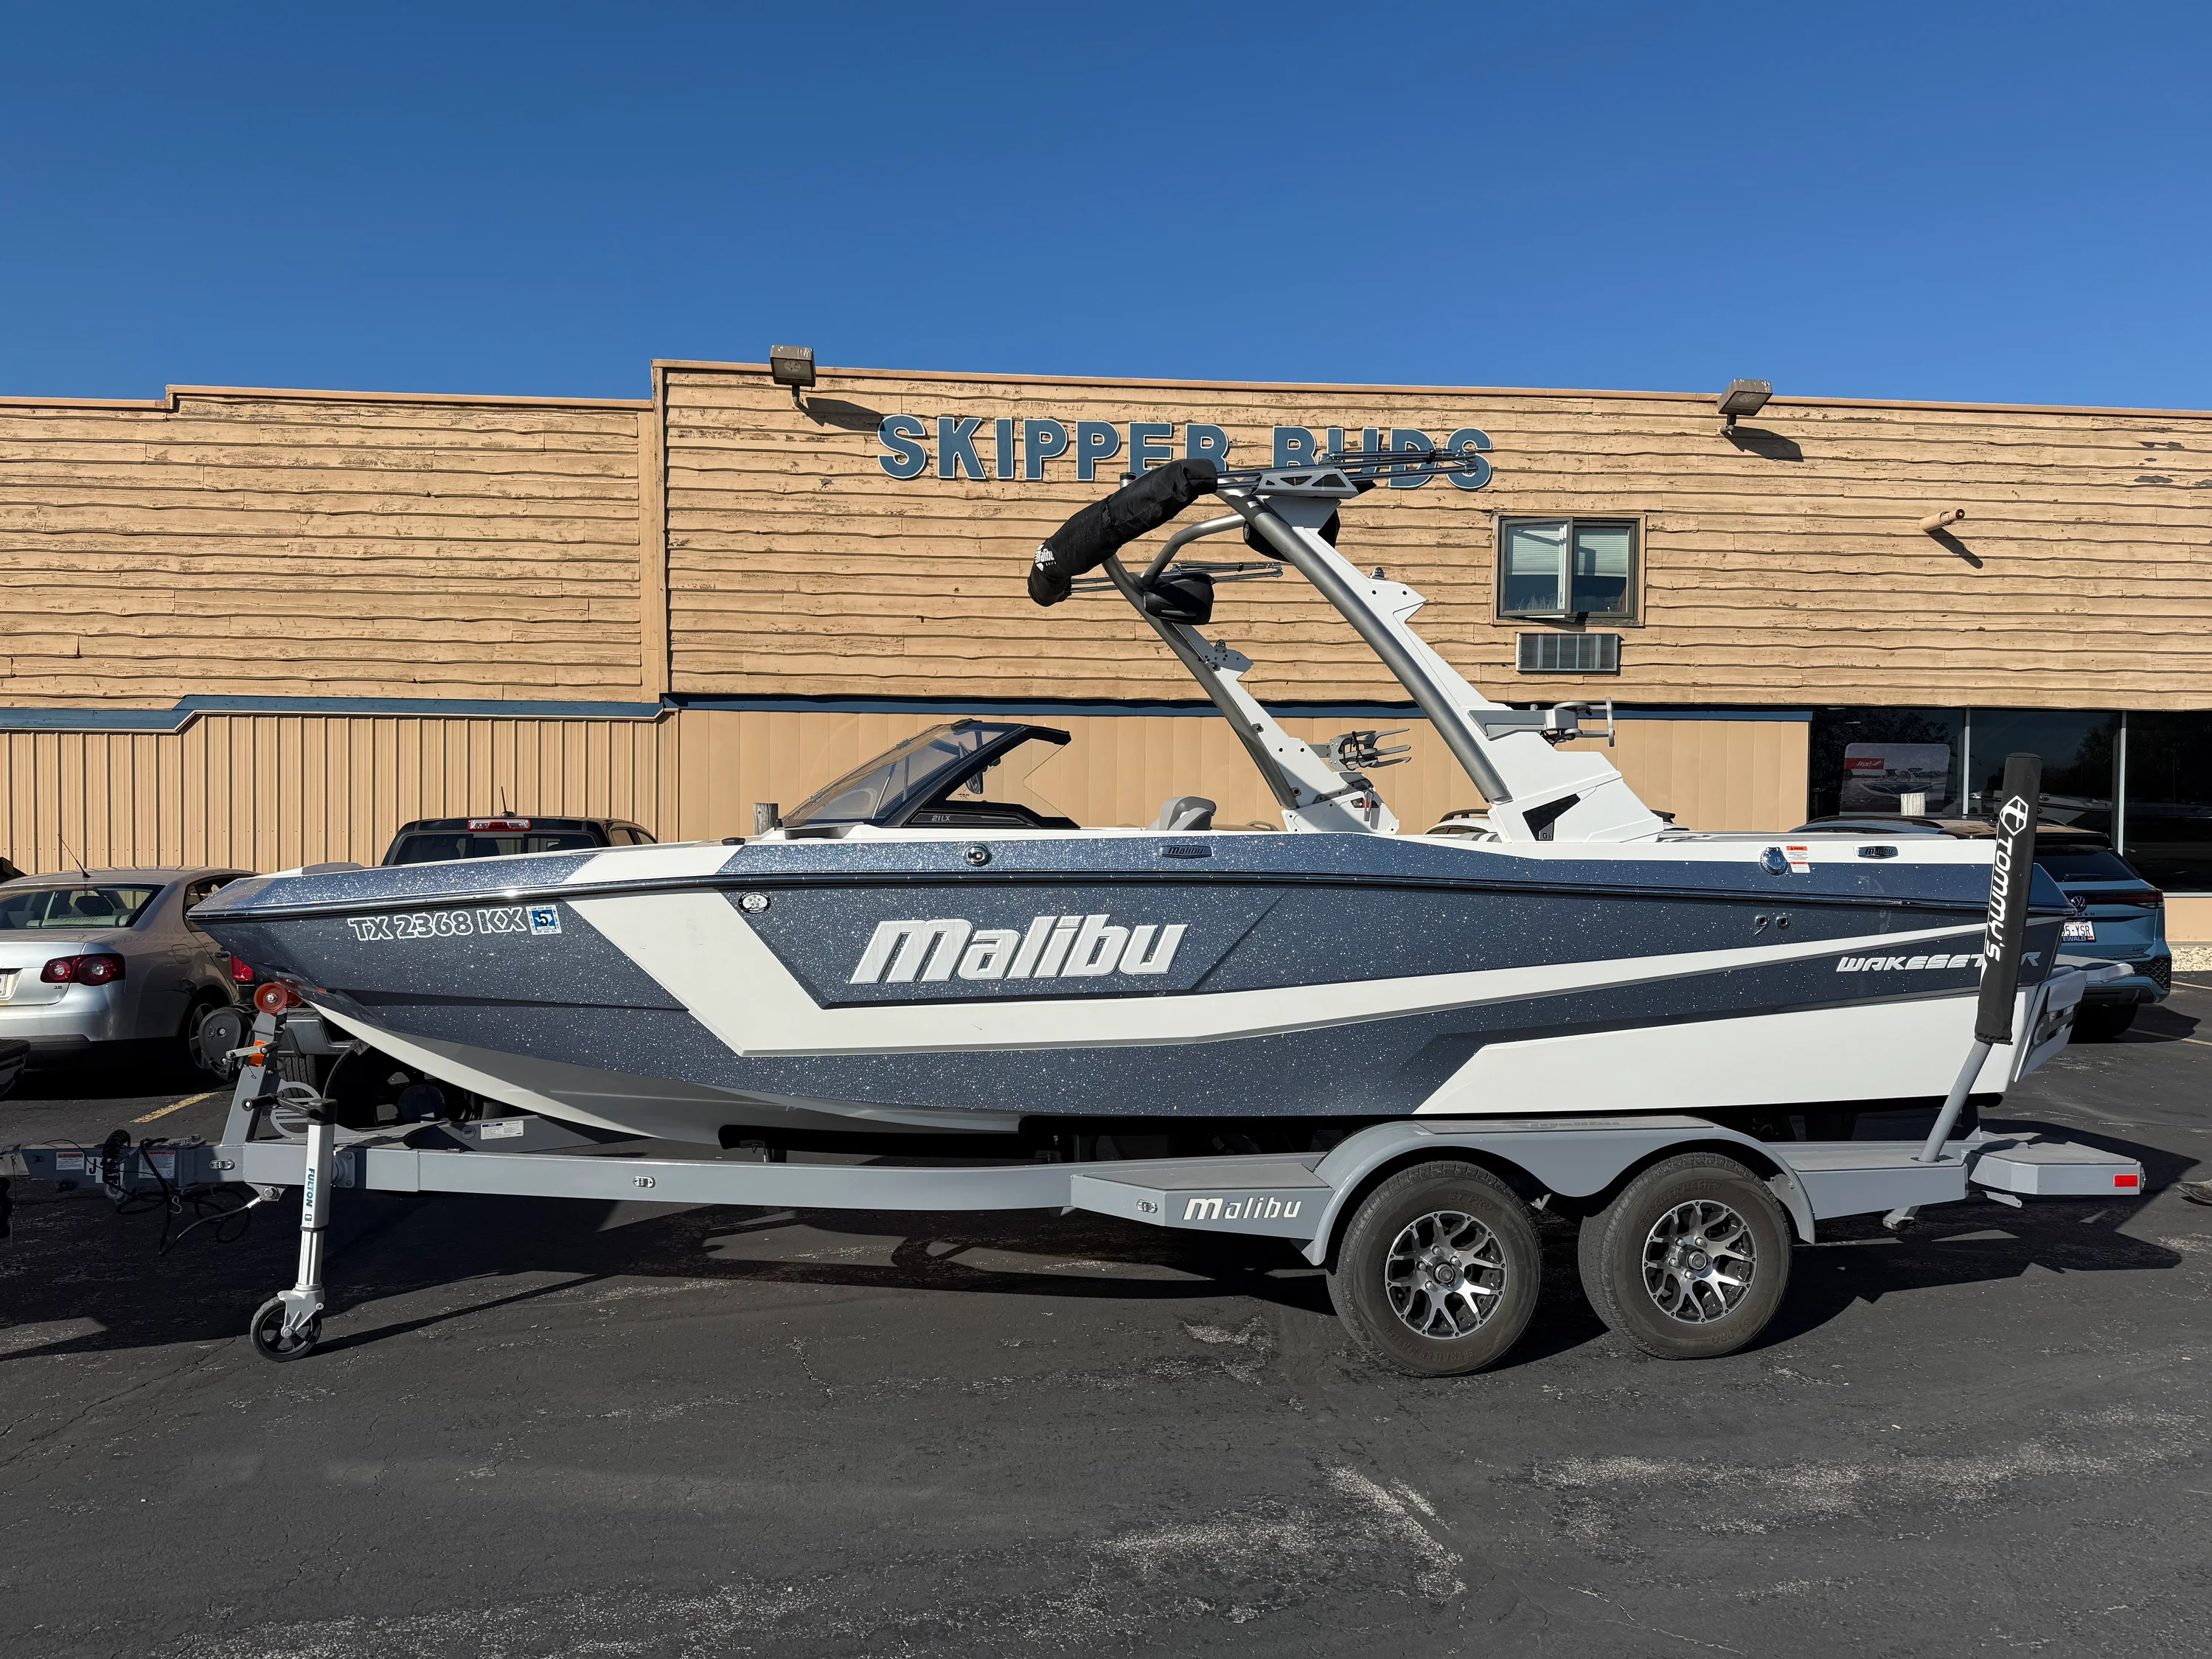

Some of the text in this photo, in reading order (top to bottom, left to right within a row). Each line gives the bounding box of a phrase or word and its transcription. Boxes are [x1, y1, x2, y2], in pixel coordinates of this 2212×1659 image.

[877, 414, 1492, 490] SKIPPER BUDS
[1168, 846, 1204, 855] Malibu
[347, 916, 394, 942] TX
[393, 911, 474, 939] 2368
[476, 907, 527, 934] KX
[849, 914, 1189, 984] Malibu
[1835, 951, 2042, 973] WAKESETR
[306, 1167, 316, 1208] FULTON
[1182, 1197, 1302, 1220] Malibu
